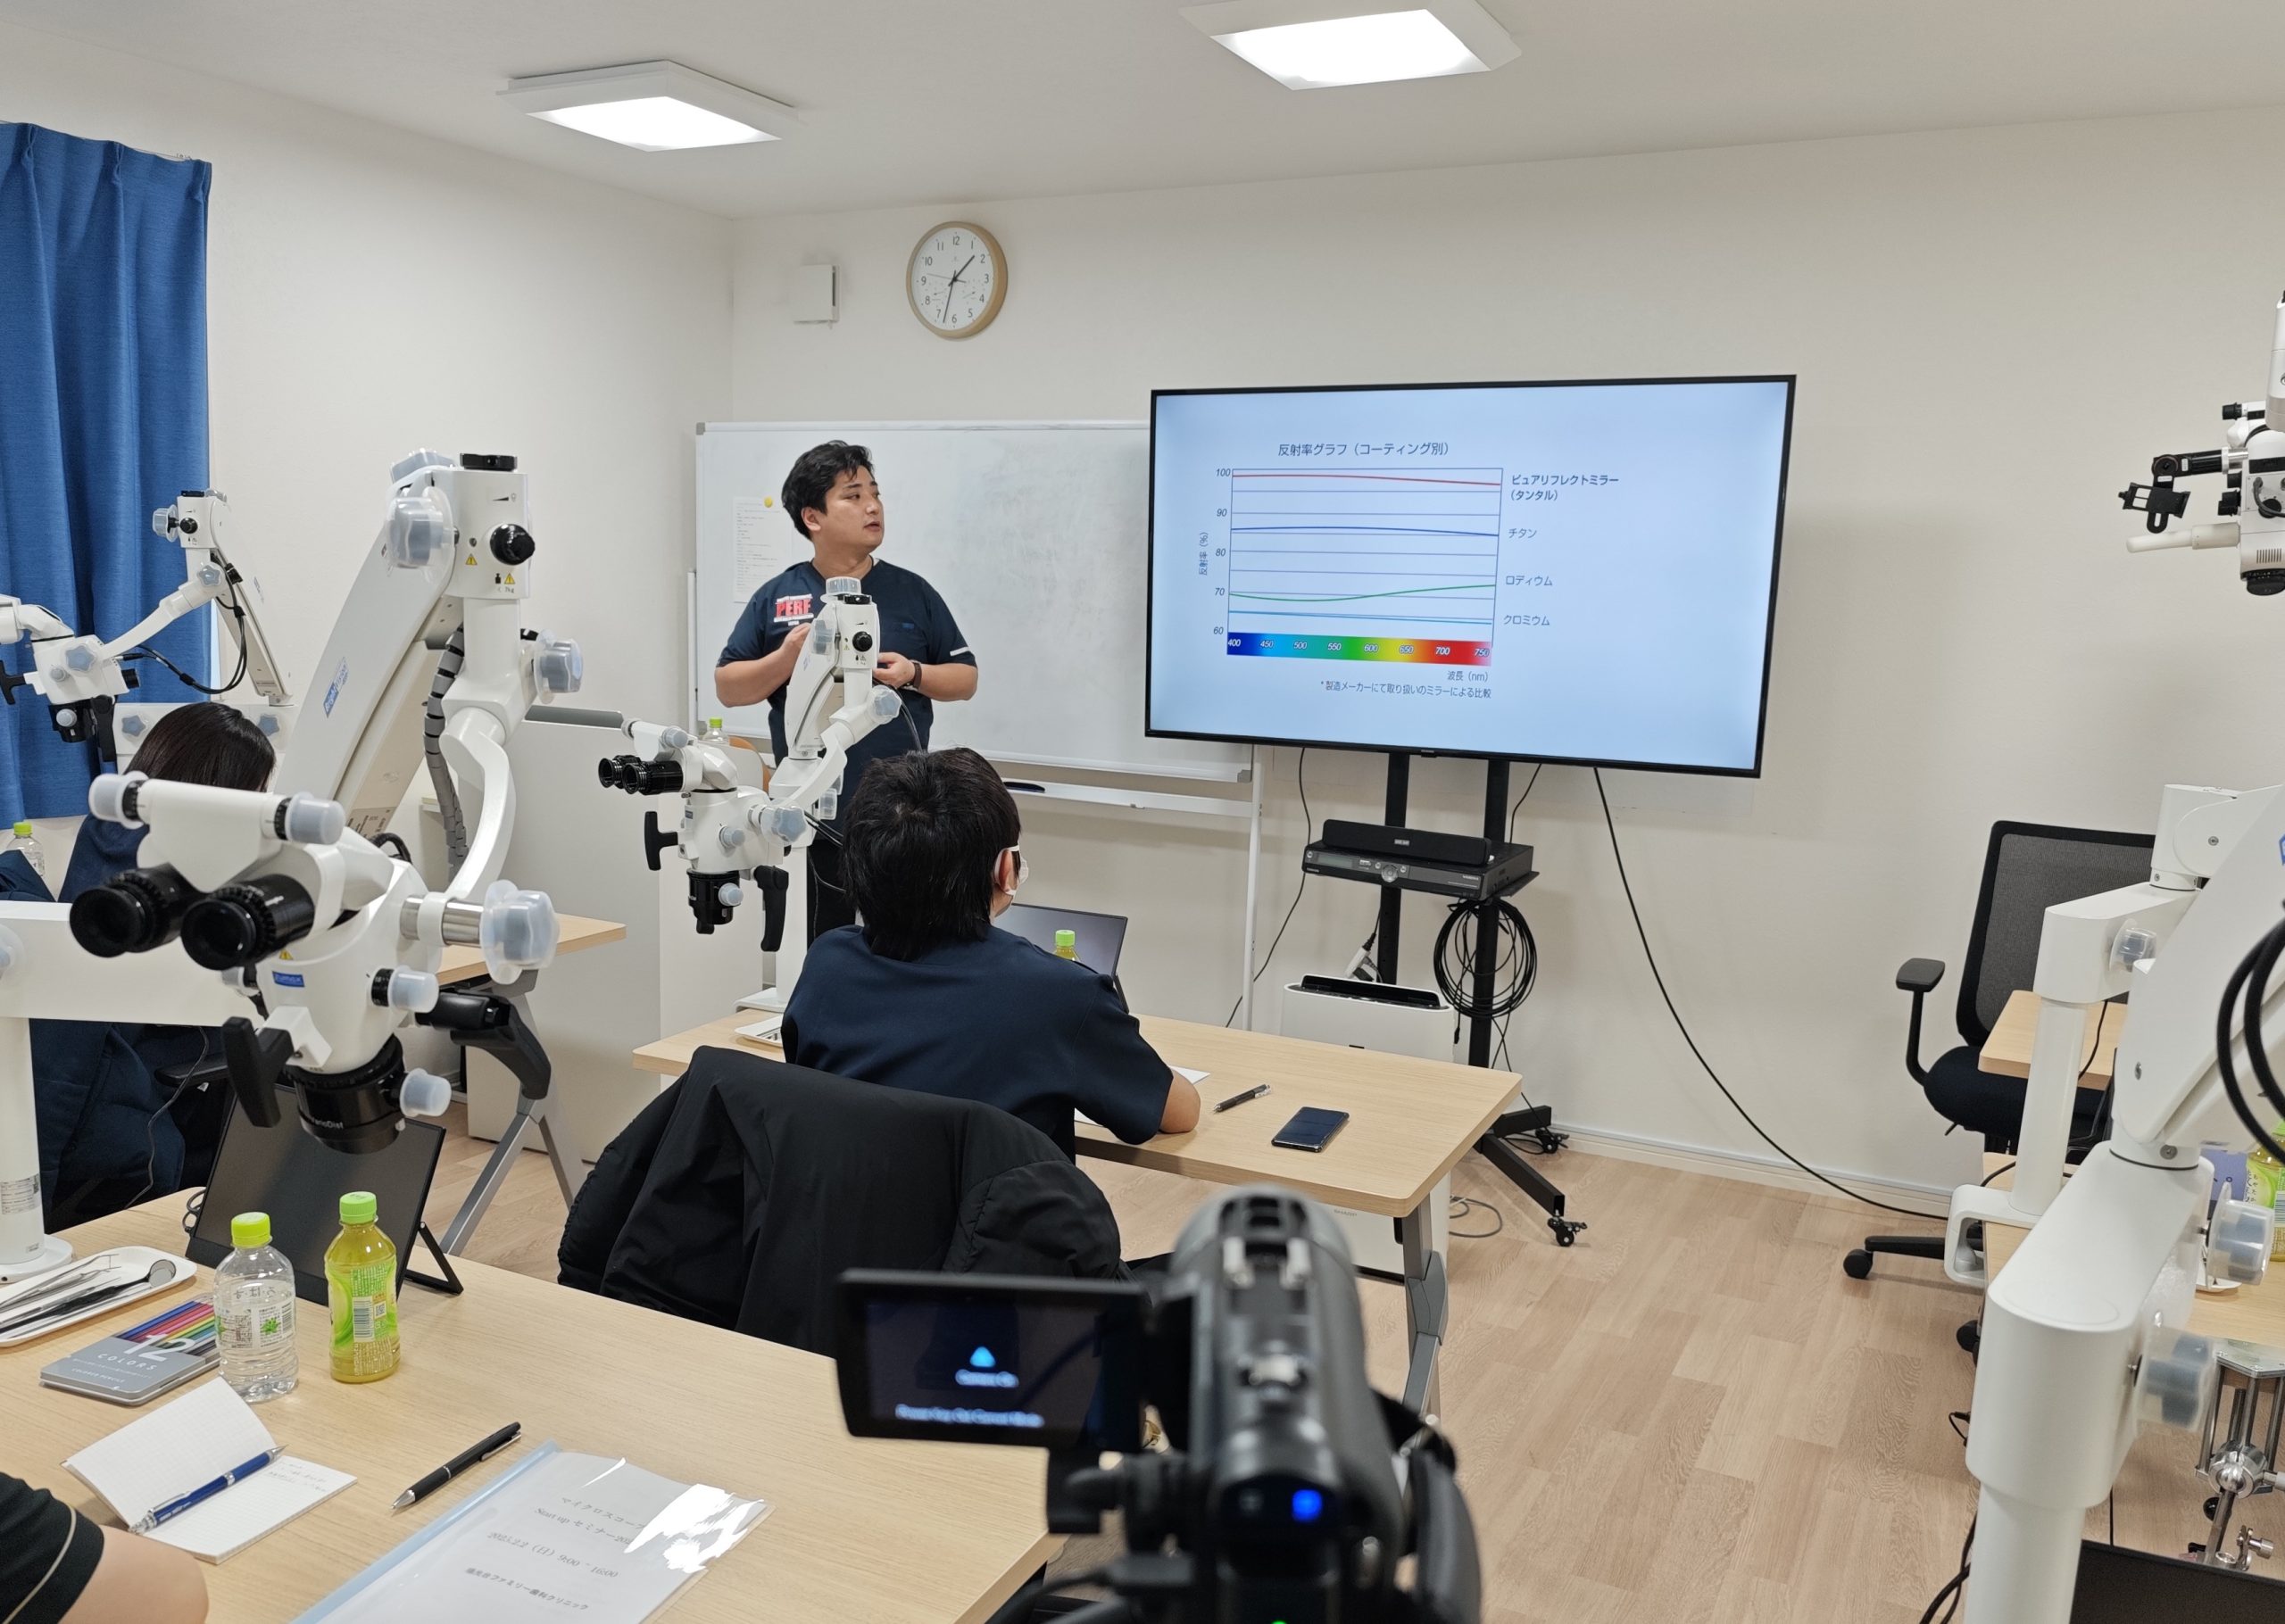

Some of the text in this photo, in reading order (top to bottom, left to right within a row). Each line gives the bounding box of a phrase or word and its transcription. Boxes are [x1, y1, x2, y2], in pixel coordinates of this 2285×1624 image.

[952, 236, 960, 246] 12
[936, 242, 944, 251] 11
[925, 256, 933, 267] 10
[980, 253, 985, 264] 2
[920, 276, 926, 286] 9
[984, 273, 990, 284] 3
[925, 295, 931, 305] 8
[979, 294, 985, 303] 4
[936, 309, 942, 319] 7
[968, 308, 974, 318] 5
[951, 314, 958, 324] 6
[1216, 468, 1231, 477] 100
[1511, 474, 1619, 486] ピュアリフレクトミラー
[1216, 508, 1227, 517] 90
[1508, 528, 1537, 539] チタン
[1215, 548, 1226, 557] 80
[1506, 576, 1553, 587] ロディウム
[1215, 587, 1226, 596] 70
[1503, 615, 1550, 626] クロミウム
[1213, 626, 1224, 635] 60
[1227, 638, 1490, 657] 400 450 500 550 600 650 700 750
[123, 1333, 195, 1362] 12
[97, 1353, 157, 1371] COLORS
